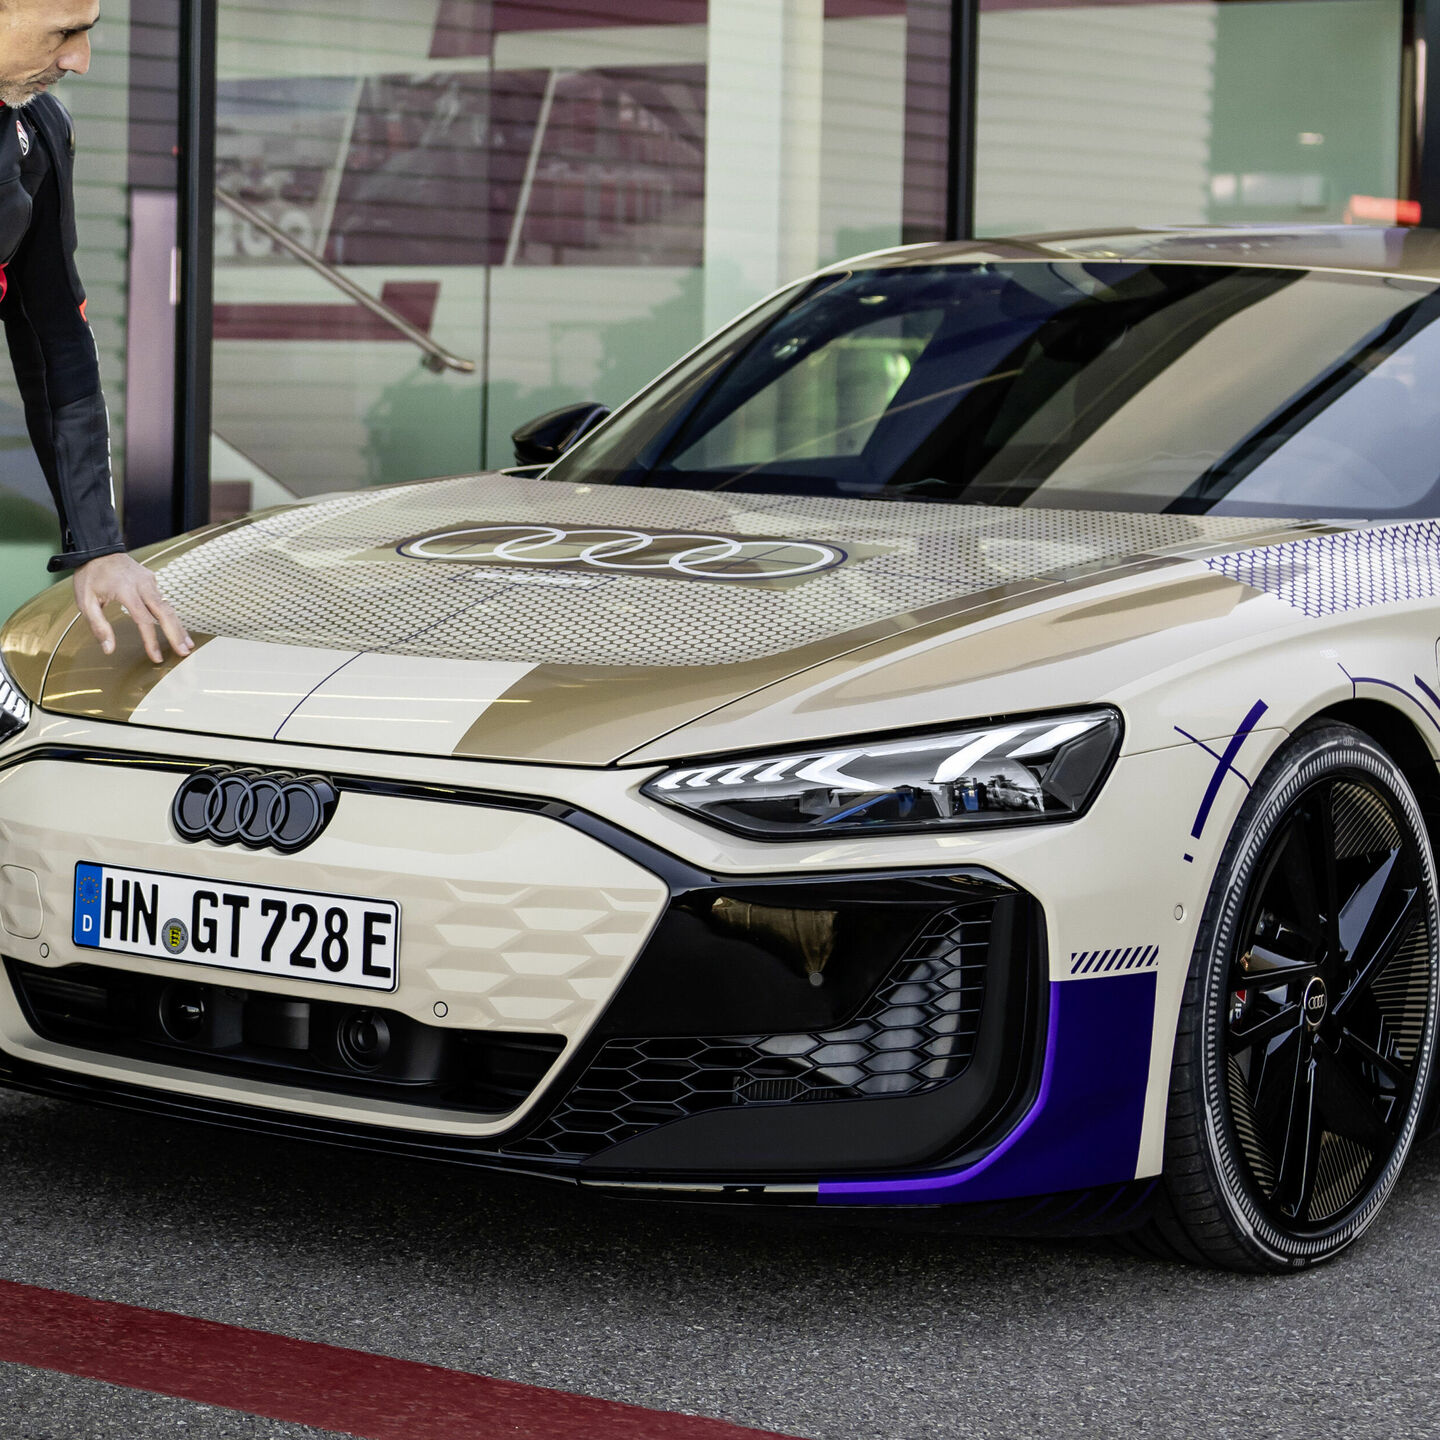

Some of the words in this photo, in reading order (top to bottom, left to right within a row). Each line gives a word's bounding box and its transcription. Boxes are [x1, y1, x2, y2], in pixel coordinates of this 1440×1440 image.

[81, 913, 94, 933] D
[103, 877, 159, 946] HN
[191, 889, 250, 958] GT
